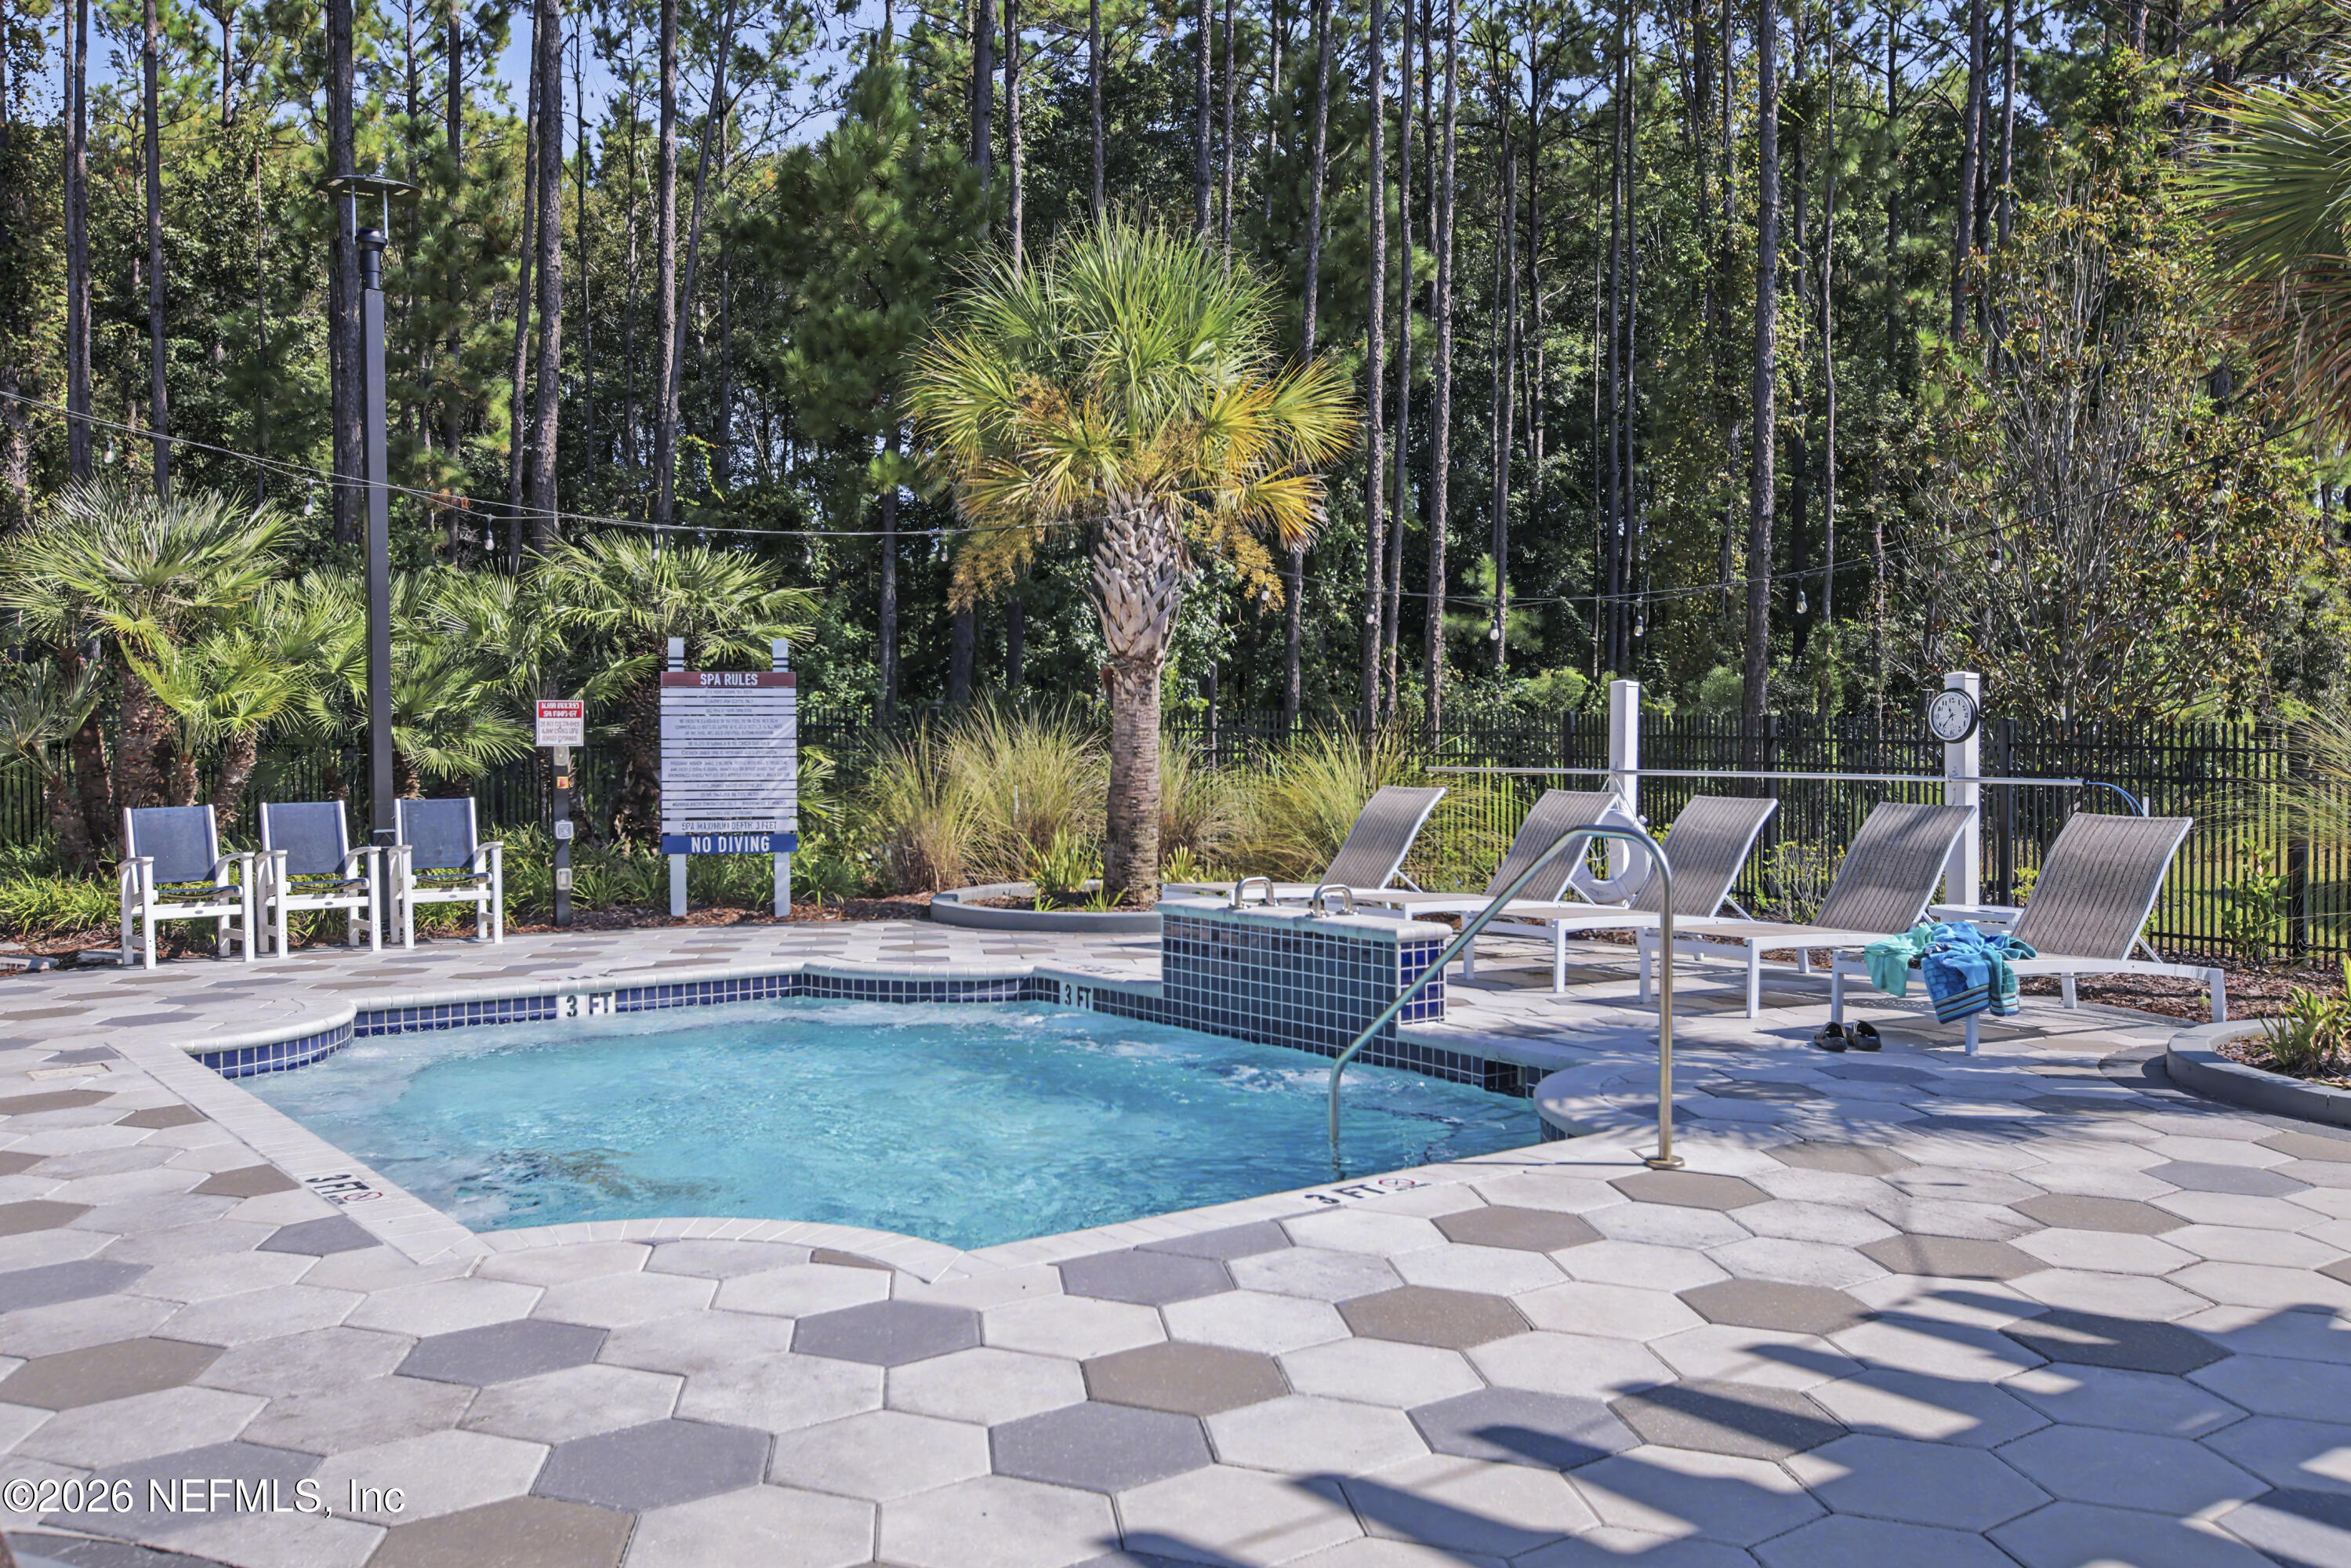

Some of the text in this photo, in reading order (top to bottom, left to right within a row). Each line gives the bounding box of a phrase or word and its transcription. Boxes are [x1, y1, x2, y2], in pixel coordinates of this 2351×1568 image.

[700, 673, 759, 686] SPA RULES
[682, 822, 695, 831] SPA
[731, 822, 753, 830] DEPTH
[691, 835, 771, 854] NO DIVING
[566, 992, 612, 1017] 3 FT
[1065, 984, 1091, 1010] 3 FT
[305, 1174, 370, 1195] 3 FT
[1304, 1194, 1341, 1204] 3
[1330, 1184, 1386, 1199] FT
